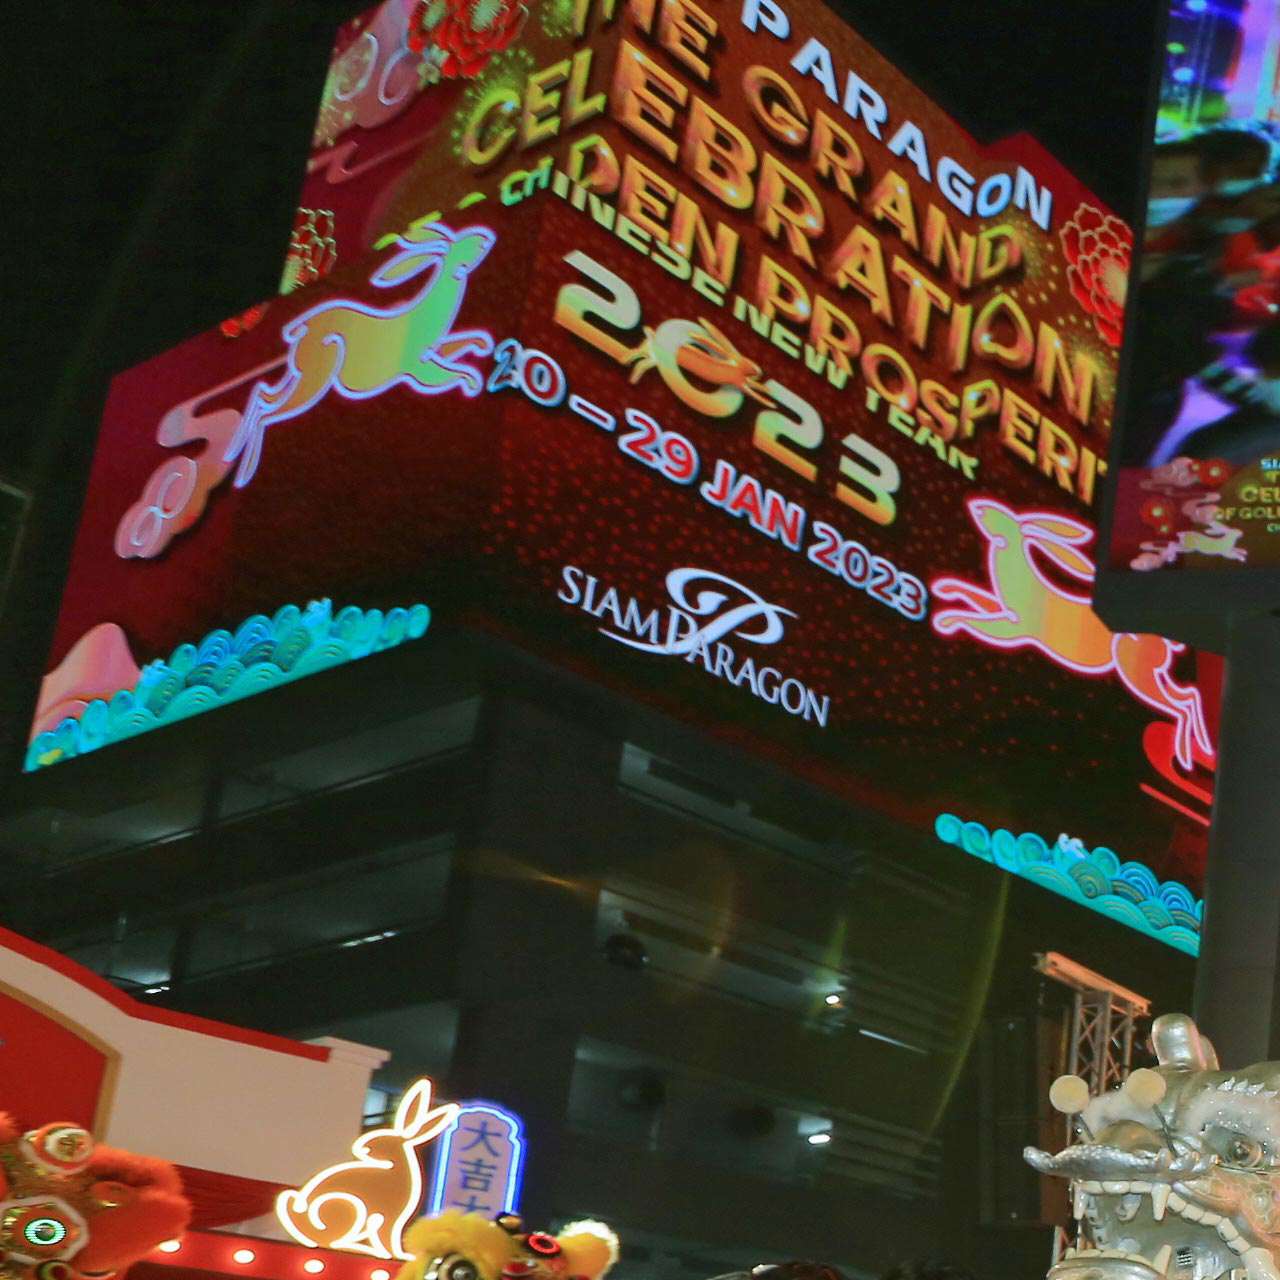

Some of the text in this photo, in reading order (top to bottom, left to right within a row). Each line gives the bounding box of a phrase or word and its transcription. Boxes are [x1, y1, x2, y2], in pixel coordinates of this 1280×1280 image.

[462, 38, 1102, 427] CELEBRATION
[743, 64, 1024, 290] GRAND
[732, 295, 848, 390] NEW
[618, 408, 699, 486] 29
[702, 460, 806, 552] JAN
[808, 520, 928, 621] 2023
[557, 566, 830, 728] SIAM PARAGON
